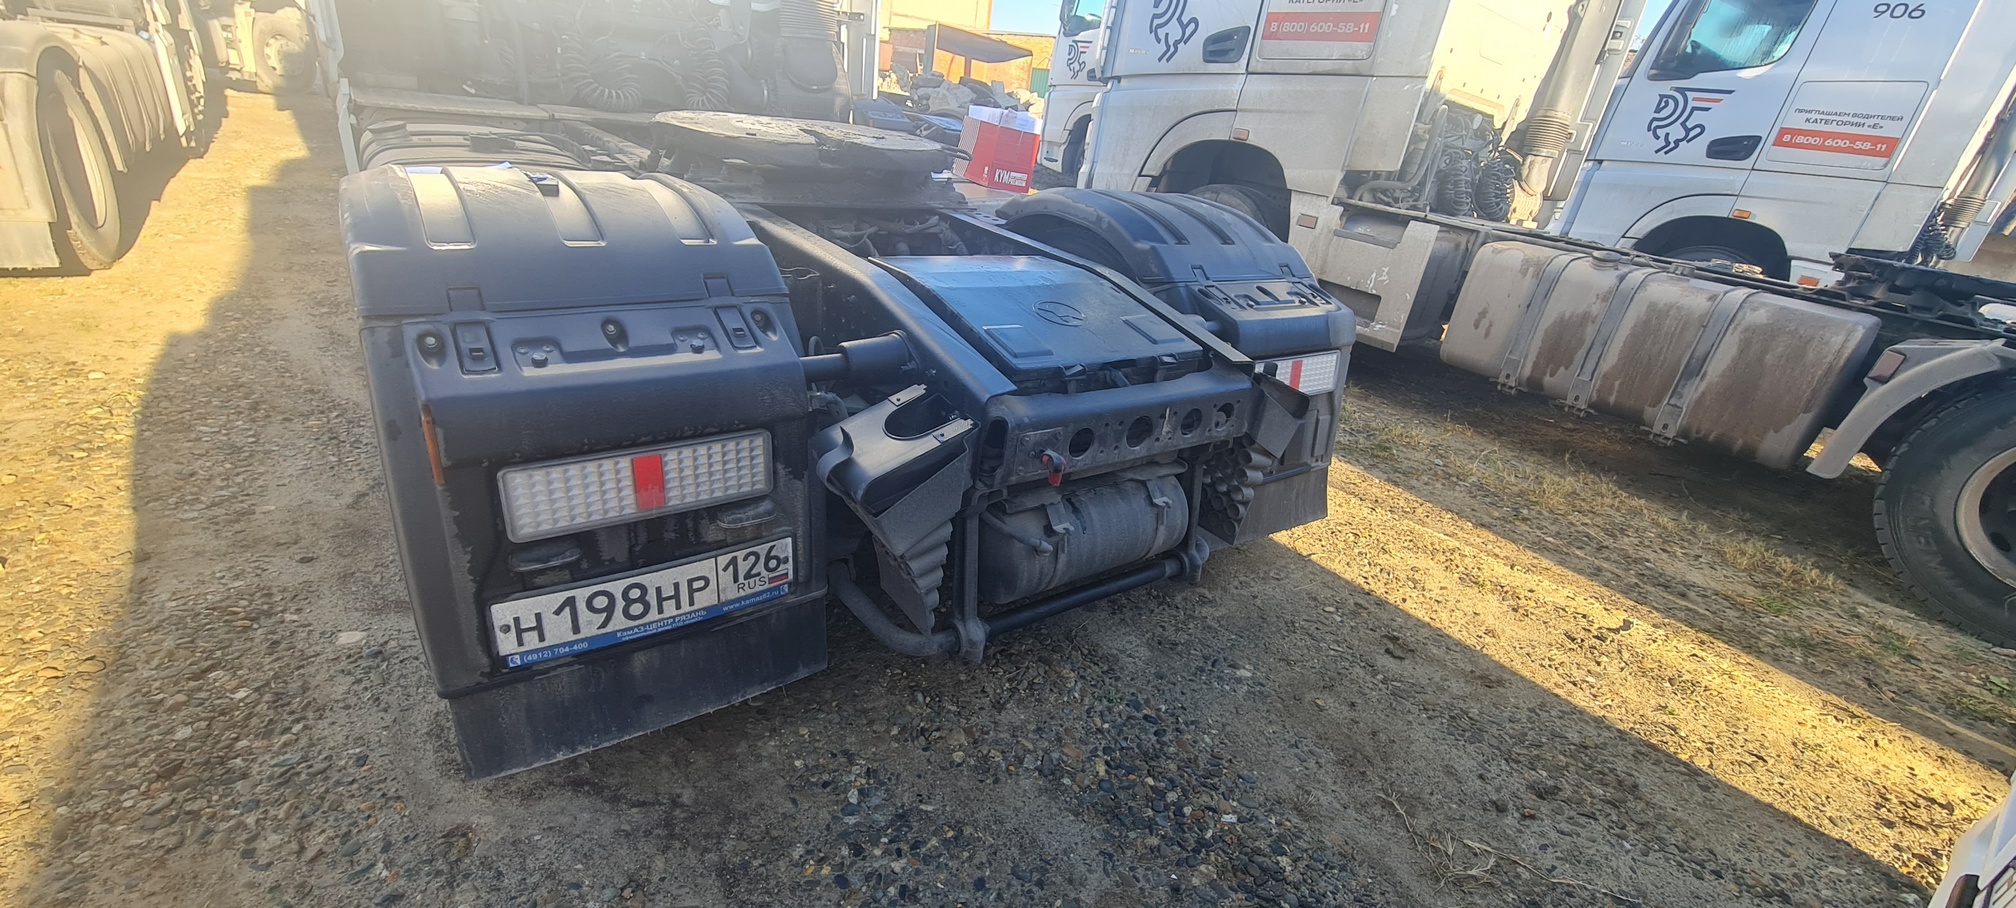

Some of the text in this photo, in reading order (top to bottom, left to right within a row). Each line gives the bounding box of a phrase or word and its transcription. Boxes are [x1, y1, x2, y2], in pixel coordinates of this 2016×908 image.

[1872, 2, 1926, 19] 906
[1269, 22, 1370, 33] 8 (800) 600-58-11
[1794, 108, 1904, 122] ПРИГЛАШАЕМ ВОДИТЕЛЕЙ
[1804, 117, 1866, 129] КАТЕГОРИИ
[1782, 134, 1887, 152] 8 (800) 600-58-11
[721, 544, 782, 585] 126
[737, 576, 767, 594] RUS
[722, 590, 779, 612] www.kamaz62.ru
[616, 618, 674, 638] КамАЗ-ЦЕНТР
[675, 609, 707, 623] РЯЗАНЬ
[523, 641, 589, 663] (4912) 704-400
